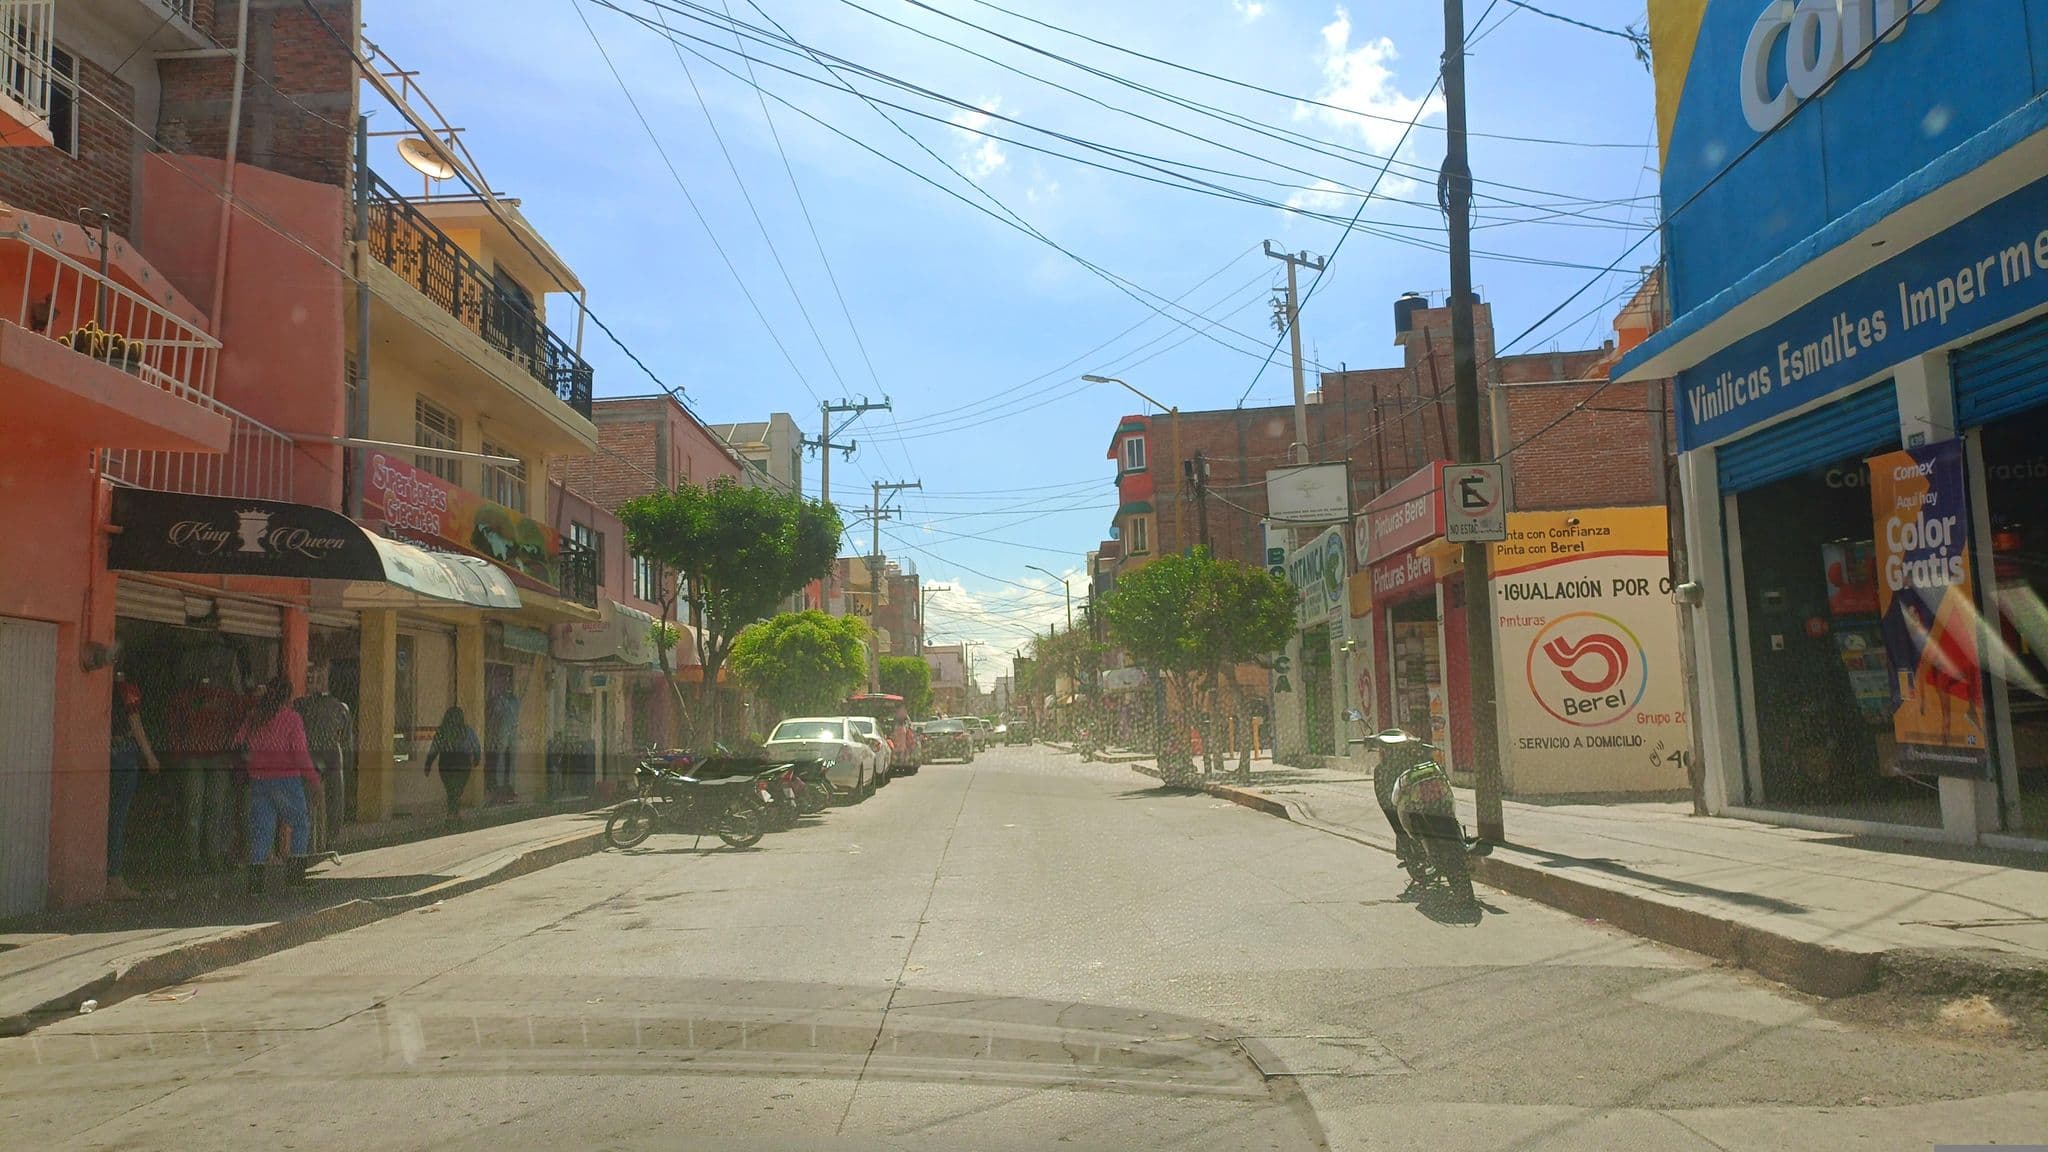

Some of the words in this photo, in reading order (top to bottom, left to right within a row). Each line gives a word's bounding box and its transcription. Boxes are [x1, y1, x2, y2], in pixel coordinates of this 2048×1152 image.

[1688, 365, 1771, 425] Vinilicas
[1778, 307, 1887, 387] Esmaltes
[1898, 229, 2048, 331] Imperme
[1919, 491, 1938, 506] hay
[1374, 510, 1404, 539] Pinturas
[1405, 495, 1427, 524] Berel
[167, 520, 231, 556] King
[269, 526, 345, 559] Queen
[1504, 529, 1524, 541] nta
[1527, 530, 1546, 540] con
[1886, 511, 1957, 553] Color
[1497, 544, 1525, 556] Pinta
[1528, 543, 1547, 554] con
[1550, 541, 1585, 553] Berel
[1373, 564, 1405, 593] Pinturas
[1406, 553, 1431, 582] Berel
[1885, 547, 1965, 592] Gratis
[1504, 575, 1602, 600] IGUALACIÓN
[1612, 577, 1650, 597] POR
[1563, 689, 1627, 716] Berel
[1637, 711, 1671, 726] Grupo
[1519, 736, 1570, 750] SERVICIO
[1573, 737, 1583, 748] A
[1586, 735, 1642, 748] DOMICILIO
